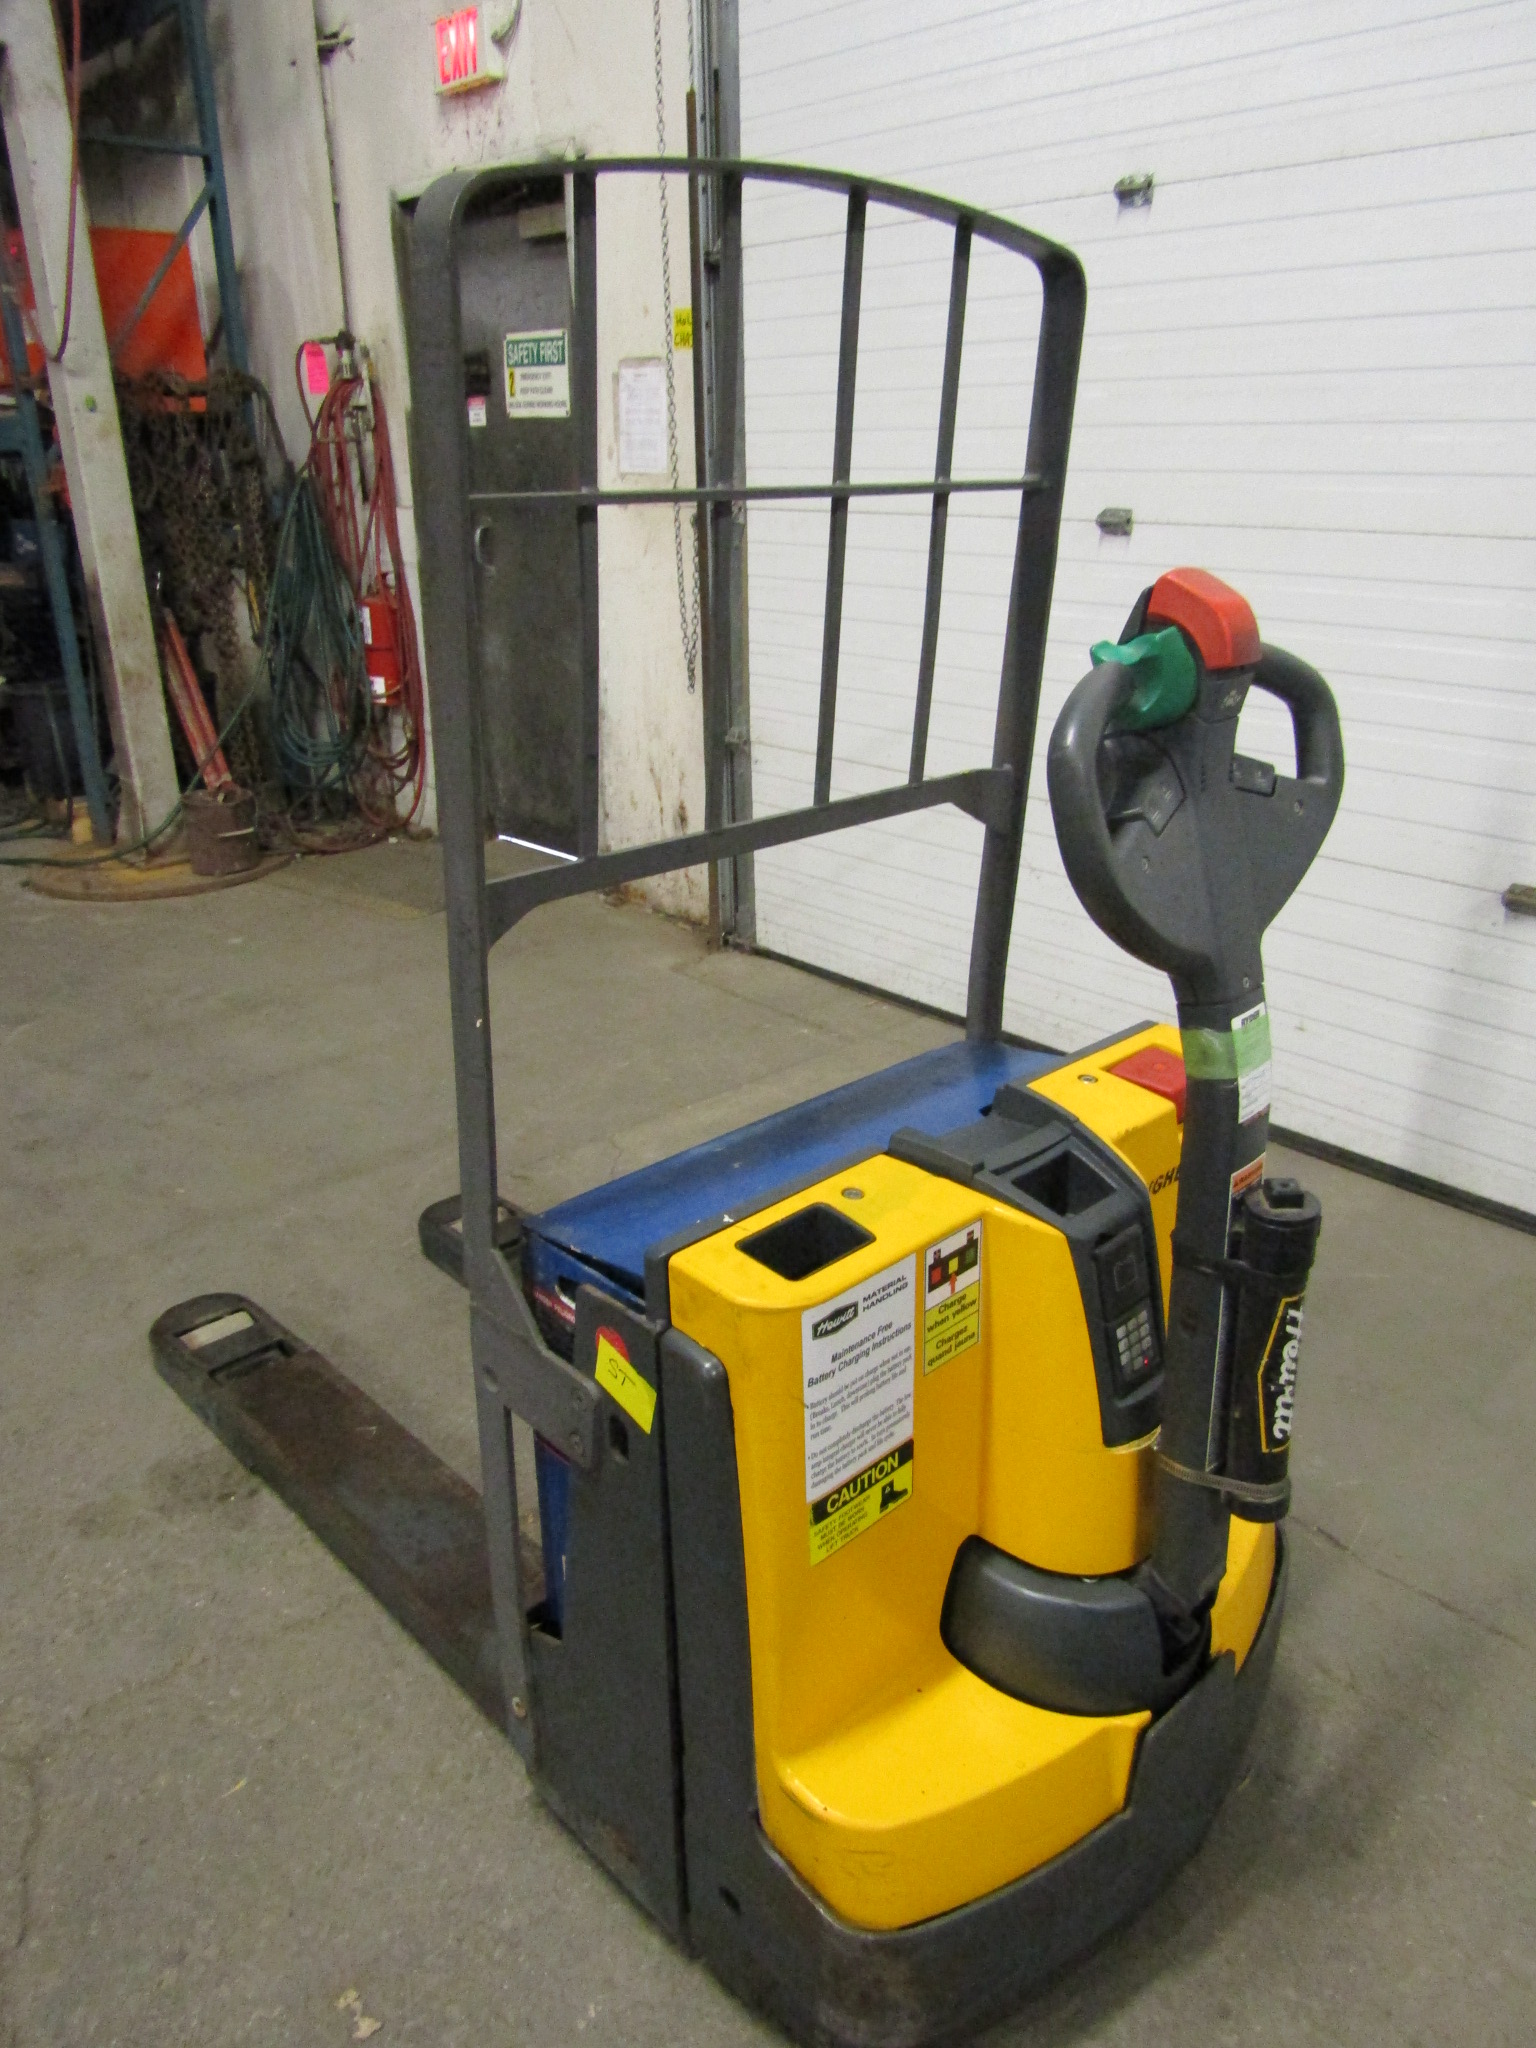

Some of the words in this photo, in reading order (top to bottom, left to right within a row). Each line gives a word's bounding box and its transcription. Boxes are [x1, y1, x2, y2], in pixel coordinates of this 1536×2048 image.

[435, 6, 478, 84] EXIT
[507, 341, 538, 365] SAFETY
[540, 339, 564, 363] FIRST
[862, 1274, 907, 1303] MATERIAL
[862, 1281, 909, 1312] HANDLING
[938, 1293, 967, 1314] Charge
[926, 1315, 949, 1333] when
[952, 1298, 977, 1320] yellow
[831, 1331, 876, 1364] Maintenance
[877, 1321, 893, 1336] Free
[927, 1344, 953, 1367] quand
[954, 1331, 976, 1351] jaune
[936, 1325, 968, 1349] Chargez
[807, 1367, 837, 1388] Battery
[838, 1346, 871, 1372] Charging
[871, 1322, 912, 1352] Instructions
[826, 1451, 899, 1514] CAUTION
[817, 1536, 834, 1549] WHEN
[836, 1513, 867, 1536] OPERATING
[820, 1528, 835, 1539] MUST
[826, 1541, 837, 1552] LIFT
[840, 1527, 858, 1541] TRUCK
